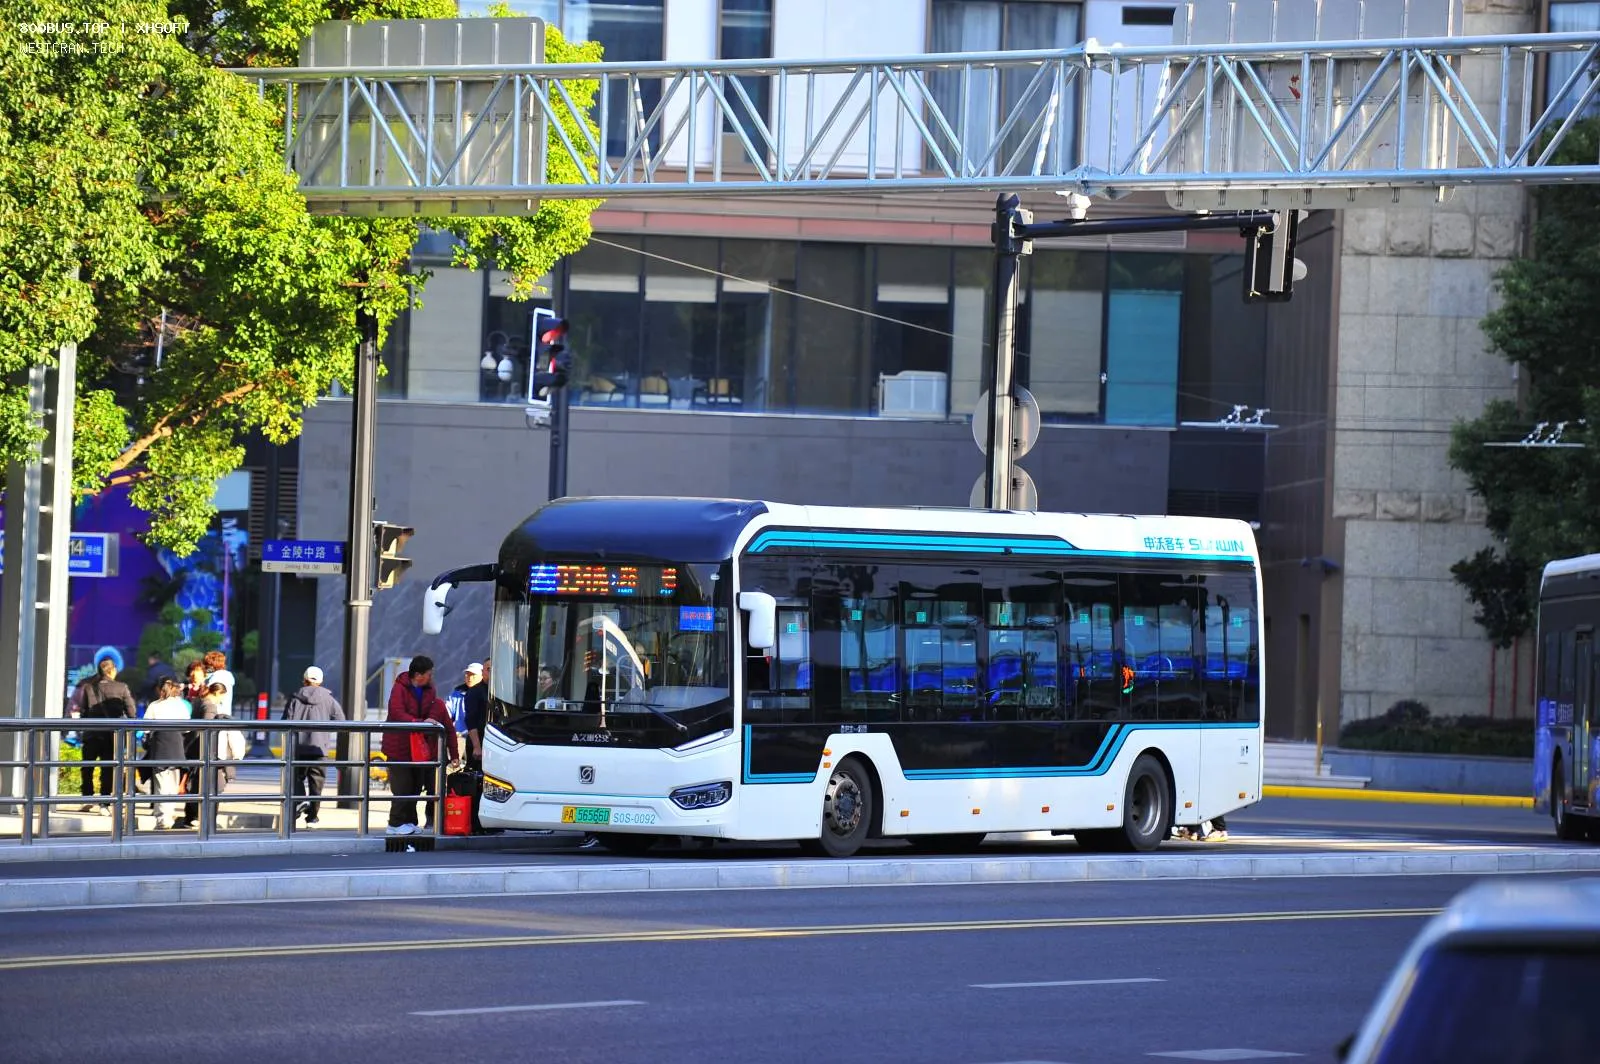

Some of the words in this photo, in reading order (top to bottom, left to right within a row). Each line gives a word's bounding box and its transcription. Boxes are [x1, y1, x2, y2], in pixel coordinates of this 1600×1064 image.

[1143, 536, 1185, 551] 申沃客车
[281, 545, 326, 559] 金陵中路
[266, 562, 272, 570] E
[332, 563, 340, 572] W
